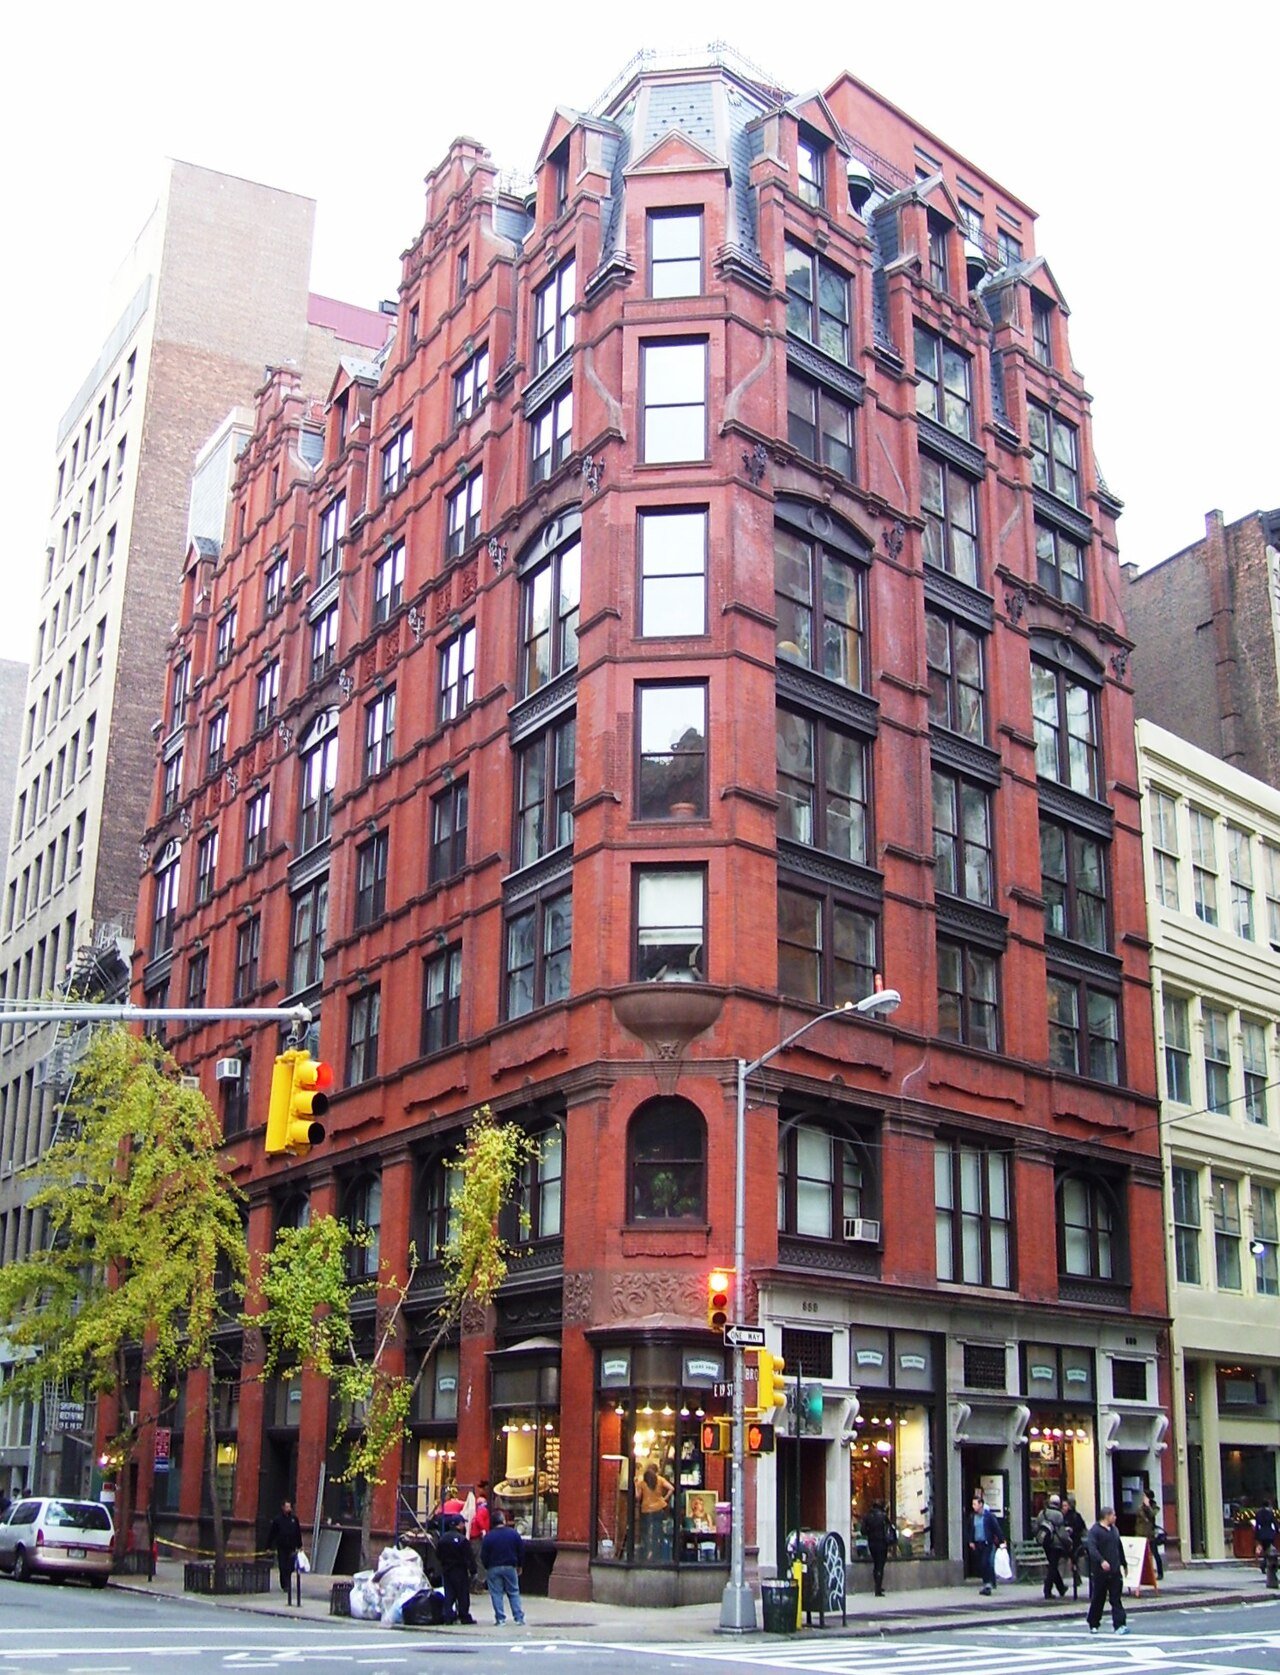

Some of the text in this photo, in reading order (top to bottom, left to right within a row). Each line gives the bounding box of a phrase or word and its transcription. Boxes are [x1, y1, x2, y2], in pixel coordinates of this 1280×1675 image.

[731, 1332, 760, 1341] ONE WAY
[727, 1384, 734, 1397] ST
